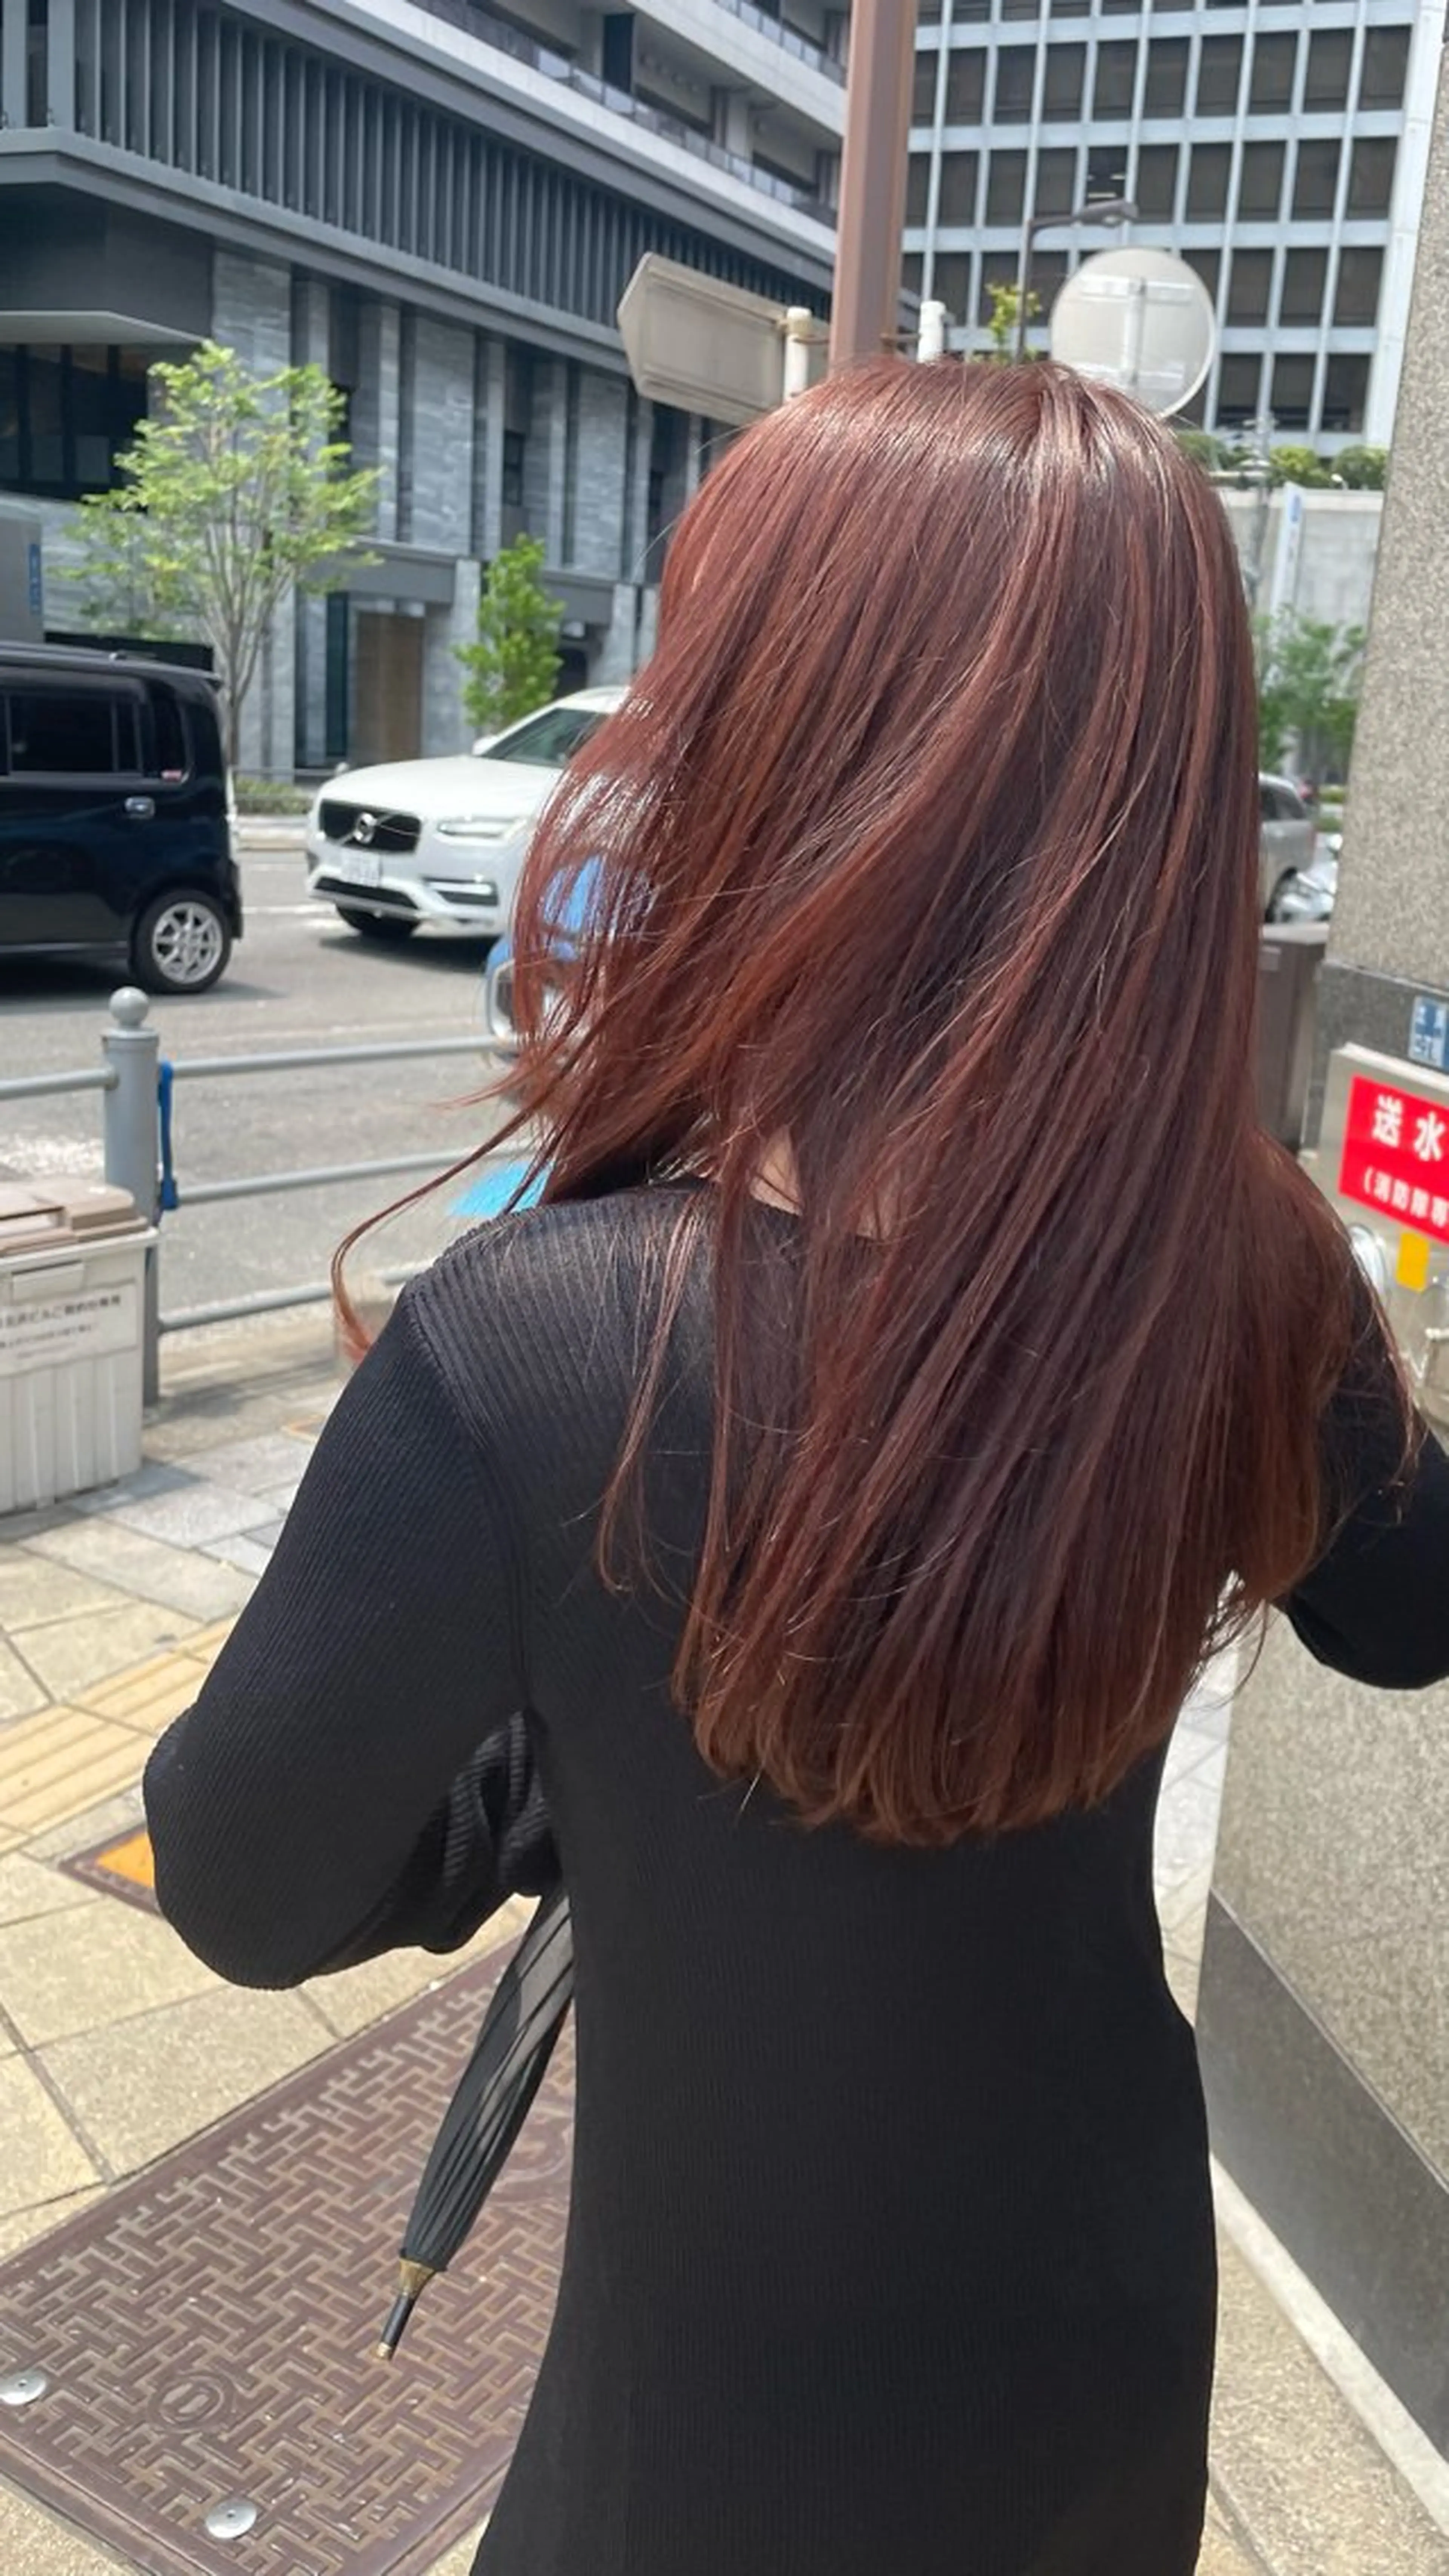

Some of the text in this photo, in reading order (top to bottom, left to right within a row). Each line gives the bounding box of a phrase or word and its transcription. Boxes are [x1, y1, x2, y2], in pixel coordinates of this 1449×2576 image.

[1372, 1093, 1446, 1161] 送水
[1363, 1166, 1449, 1228] (消防隊専
